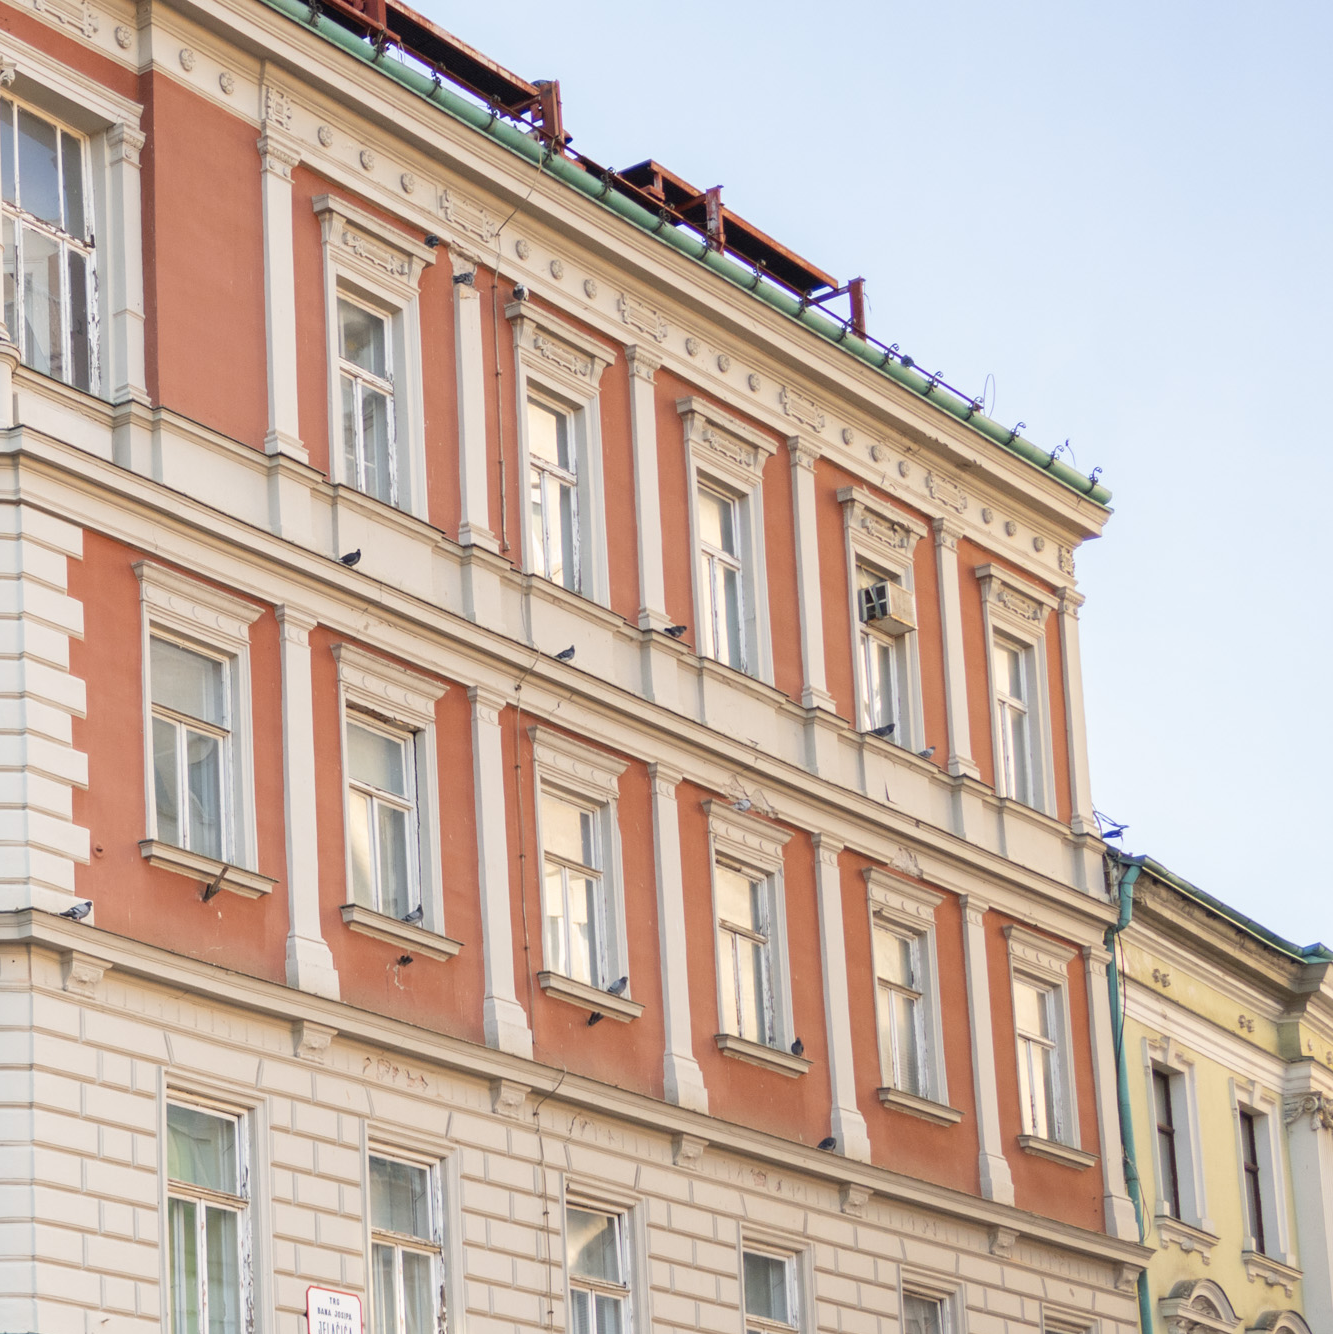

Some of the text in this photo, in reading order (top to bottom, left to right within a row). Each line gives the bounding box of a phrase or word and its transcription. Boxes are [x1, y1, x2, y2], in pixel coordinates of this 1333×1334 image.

[329, 1296, 340, 1306] TRG
[317, 1307, 352, 1321] BANA JOSIPA
